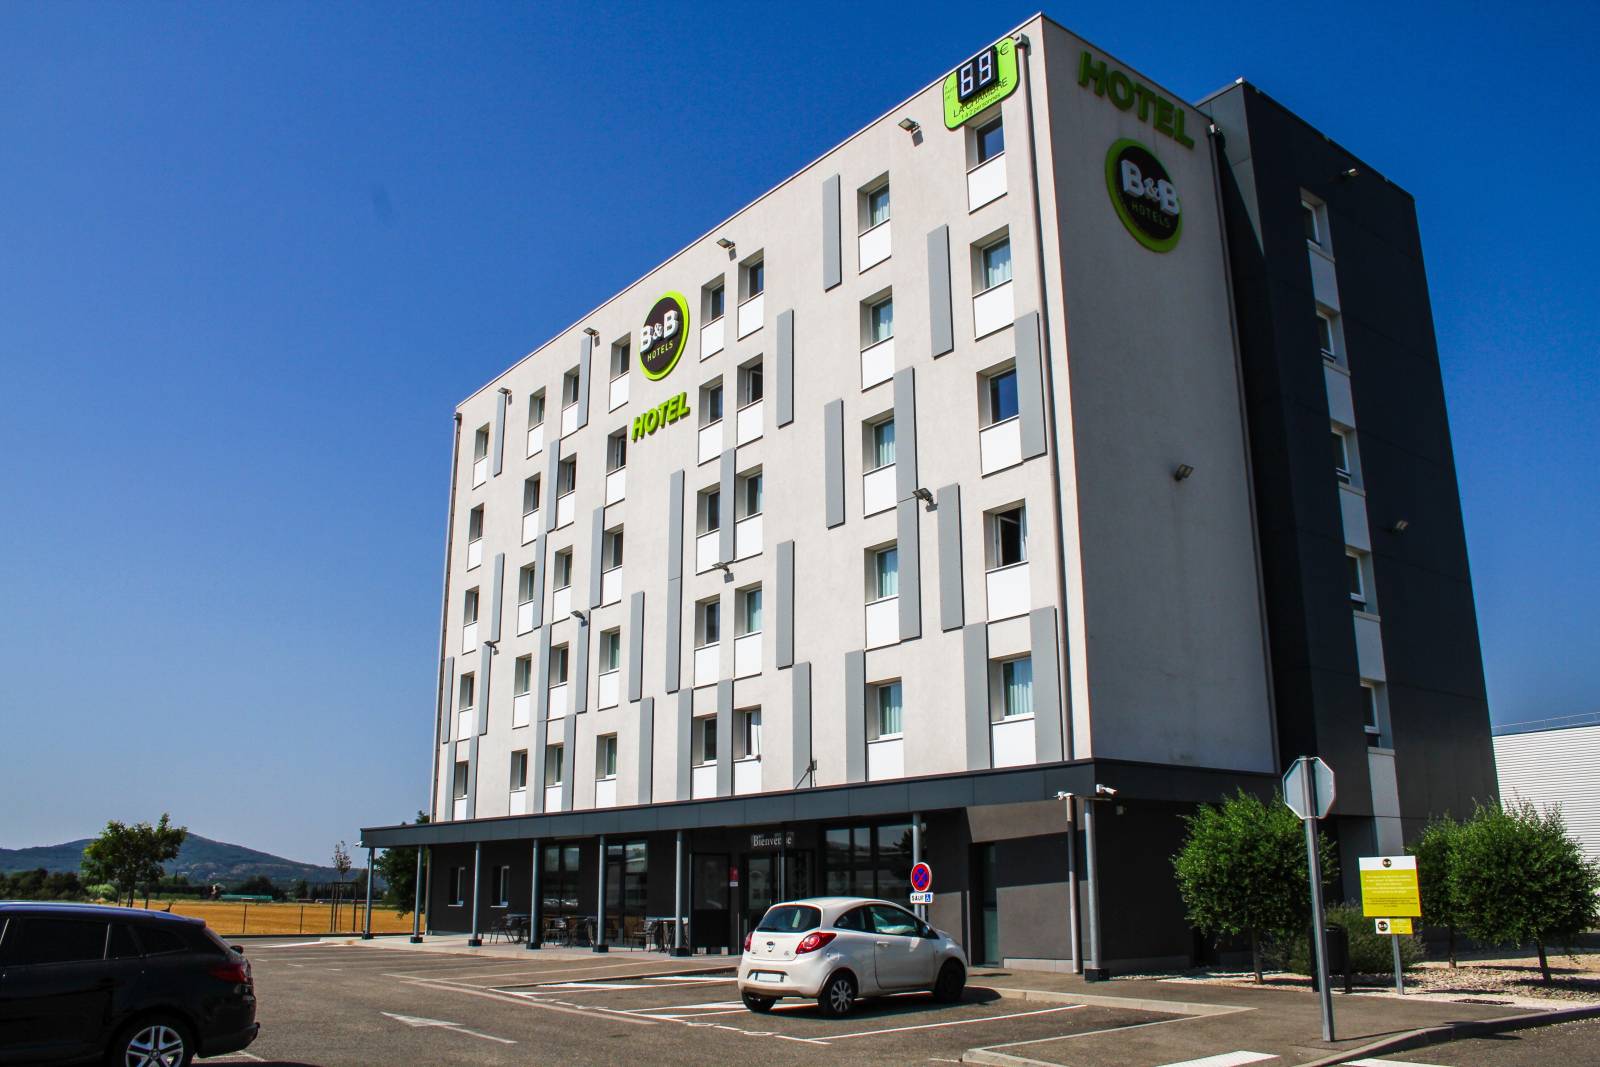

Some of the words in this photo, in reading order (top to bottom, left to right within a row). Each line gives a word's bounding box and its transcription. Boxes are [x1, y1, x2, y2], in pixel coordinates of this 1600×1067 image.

[953, 104, 965, 118] LA
[1078, 51, 1195, 150] HOTEL
[1121, 160, 1179, 215] B&B
[1131, 200, 1171, 229] HOTELS
[639, 309, 679, 353] B&B
[647, 341, 674, 361] HOTELS
[631, 391, 690, 442] HOTEL
